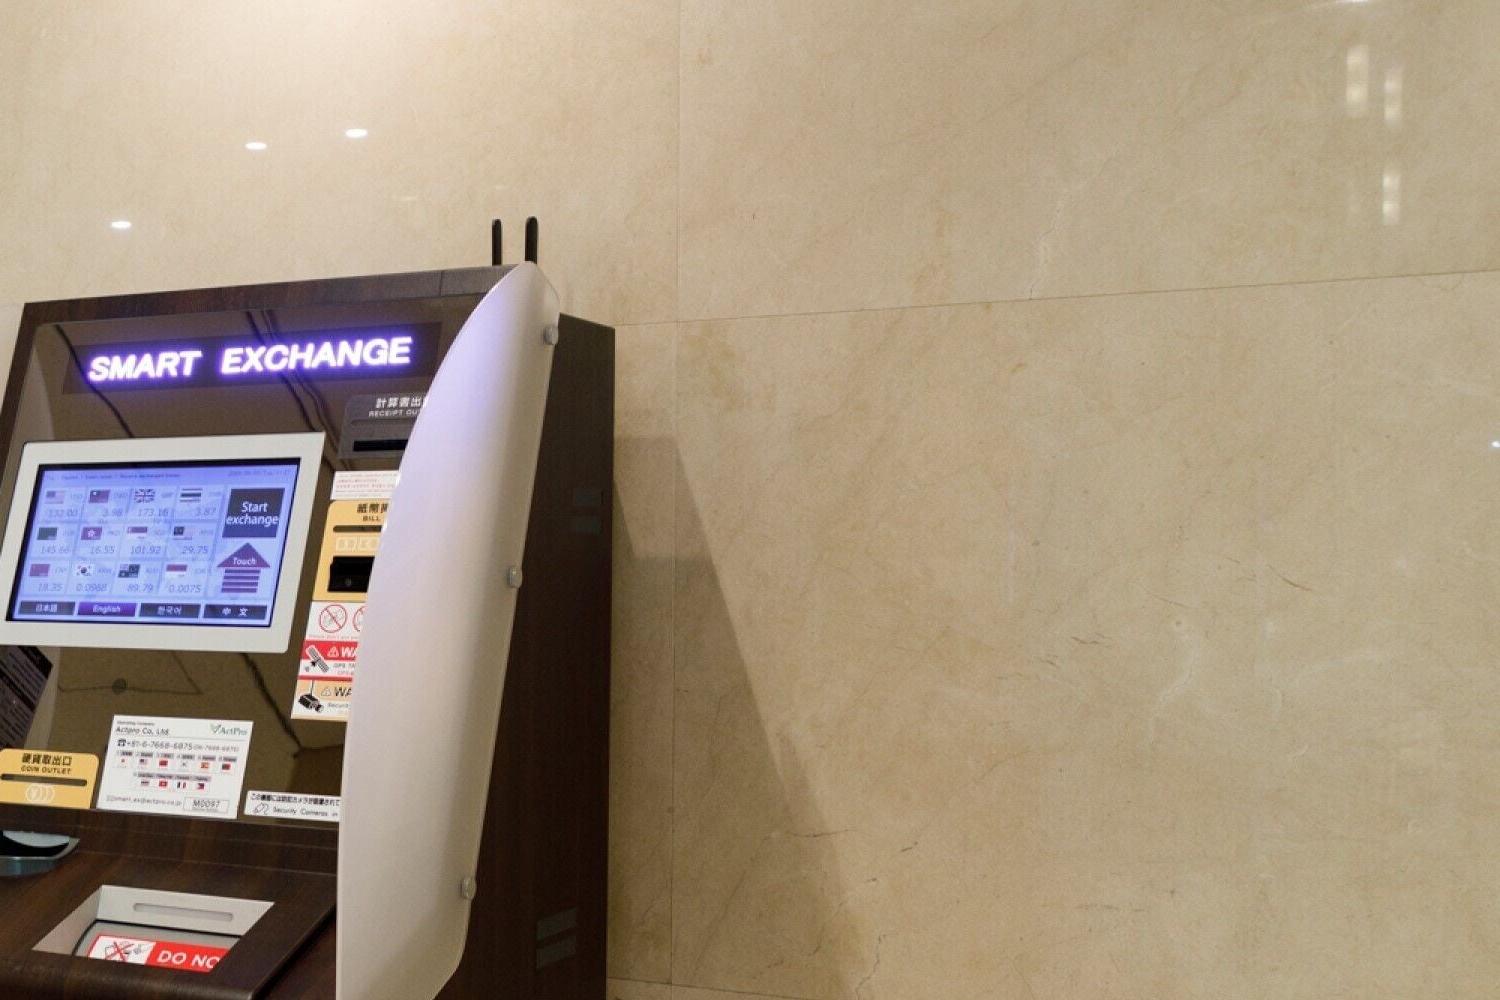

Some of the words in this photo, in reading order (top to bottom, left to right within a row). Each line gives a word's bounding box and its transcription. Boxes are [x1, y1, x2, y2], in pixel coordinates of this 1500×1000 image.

[89, 351, 203, 382] SMART
[220, 336, 413, 375] EXCHANGE
[375, 396, 423, 408] 計算書出
[241, 501, 268, 513] Start
[226, 514, 279, 528] exchange
[130, 545, 161, 554] 101.92
[182, 546, 209, 554] 29.75
[233, 557, 258, 565] Touch
[168, 584, 201, 593] 0.0075
[92, 604, 121, 614] English
[156, 605, 182, 615] 한국어
[115, 726, 140, 734] Actpro
[220, 725, 248, 735] ActPro
[22, 753, 72, 766] 硬貨取出口
[21, 765, 40, 773] COIN
[42, 766, 72, 775] OUTLET
[192, 799, 220, 808] M0097
[273, 806, 297, 814] Security
[300, 808, 328, 817] Cameras
[157, 950, 187, 965] DO
